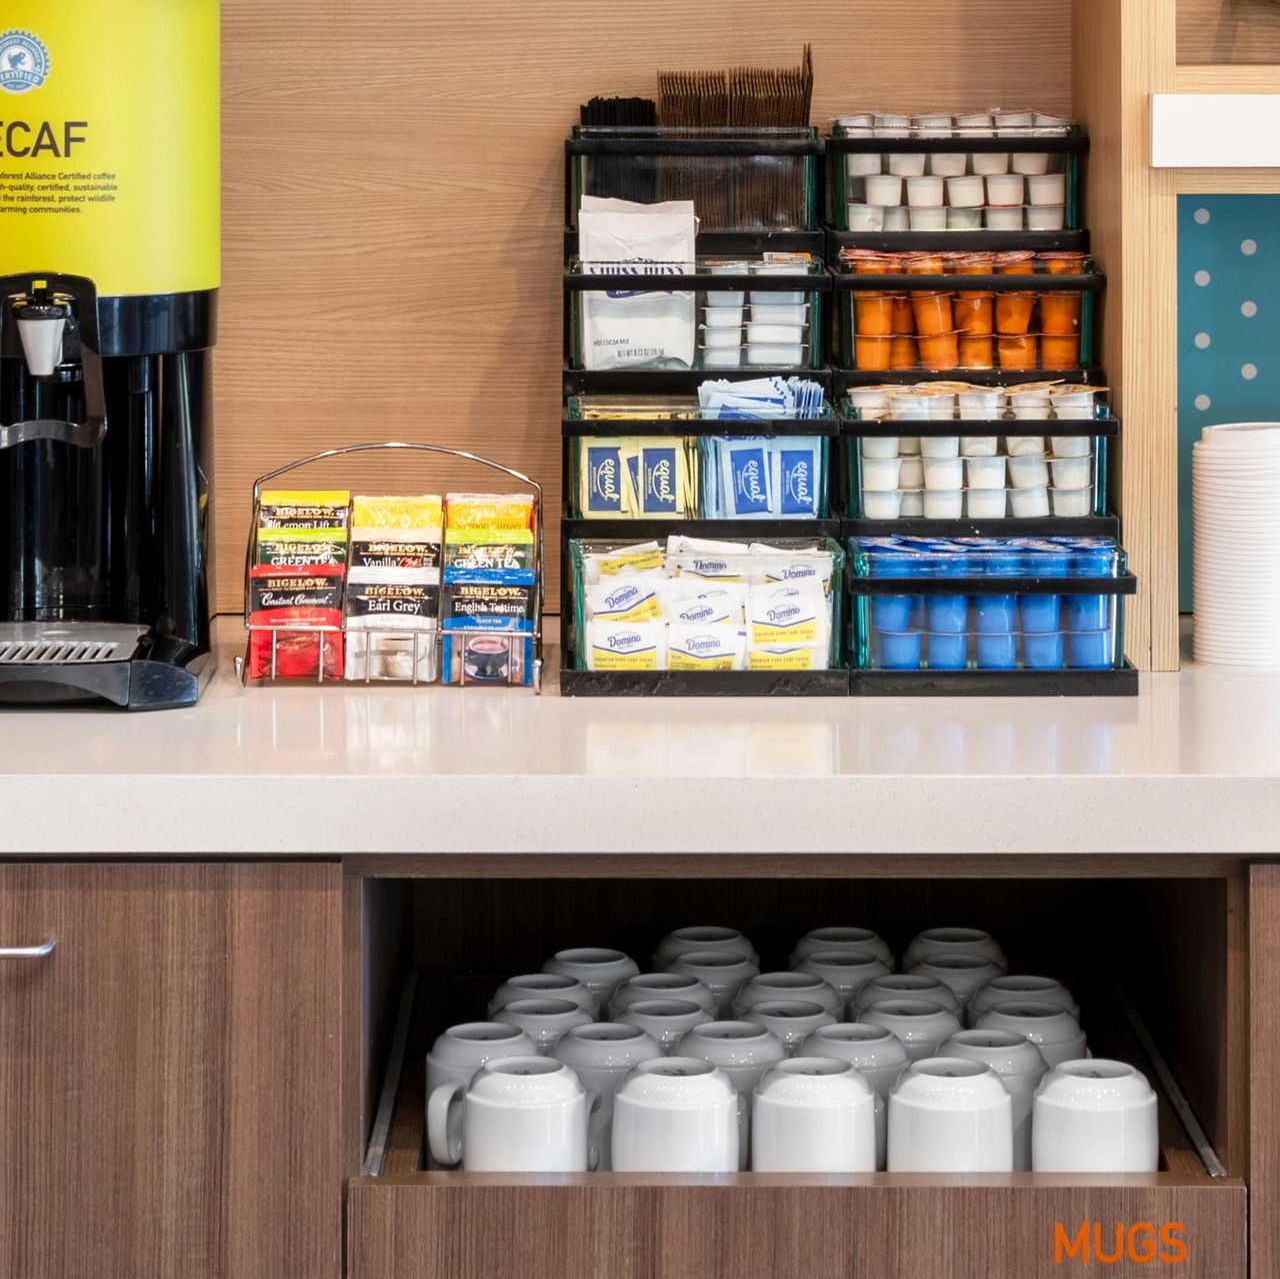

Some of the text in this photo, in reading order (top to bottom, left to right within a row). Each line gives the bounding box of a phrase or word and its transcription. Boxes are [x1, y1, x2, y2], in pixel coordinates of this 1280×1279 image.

[24, 172, 56, 180] Alliance
[58, 172, 91, 180] Certified
[93, 172, 116, 180] coffee
[73, 183, 118, 191] sustainable
[3, 193, 15, 201] the
[58, 194, 86, 203] protect
[88, 194, 116, 202] wildlife
[601, 459, 620, 501] equal
[656, 460, 675, 502] equal
[745, 460, 766, 502] equal
[794, 461, 812, 504] equal
[271, 556, 310, 567] GREEN
[363, 557, 396, 568] Vanilla
[693, 559, 727, 570] Domino
[782, 568, 816, 579] Domino
[267, 578, 328, 588] BIGELOW
[364, 586, 425, 596] BIGELOW
[460, 586, 522, 596] BIGELOW
[605, 586, 638, 608] Domino
[368, 600, 420, 615] Earl Grey
[455, 602, 487, 614] English
[680, 607, 714, 620] Domino
[767, 607, 800, 621] Domino
[607, 635, 641, 648] Domino
[686, 638, 721, 650] Domino
[1053, 1221, 1189, 1265] MUGS
